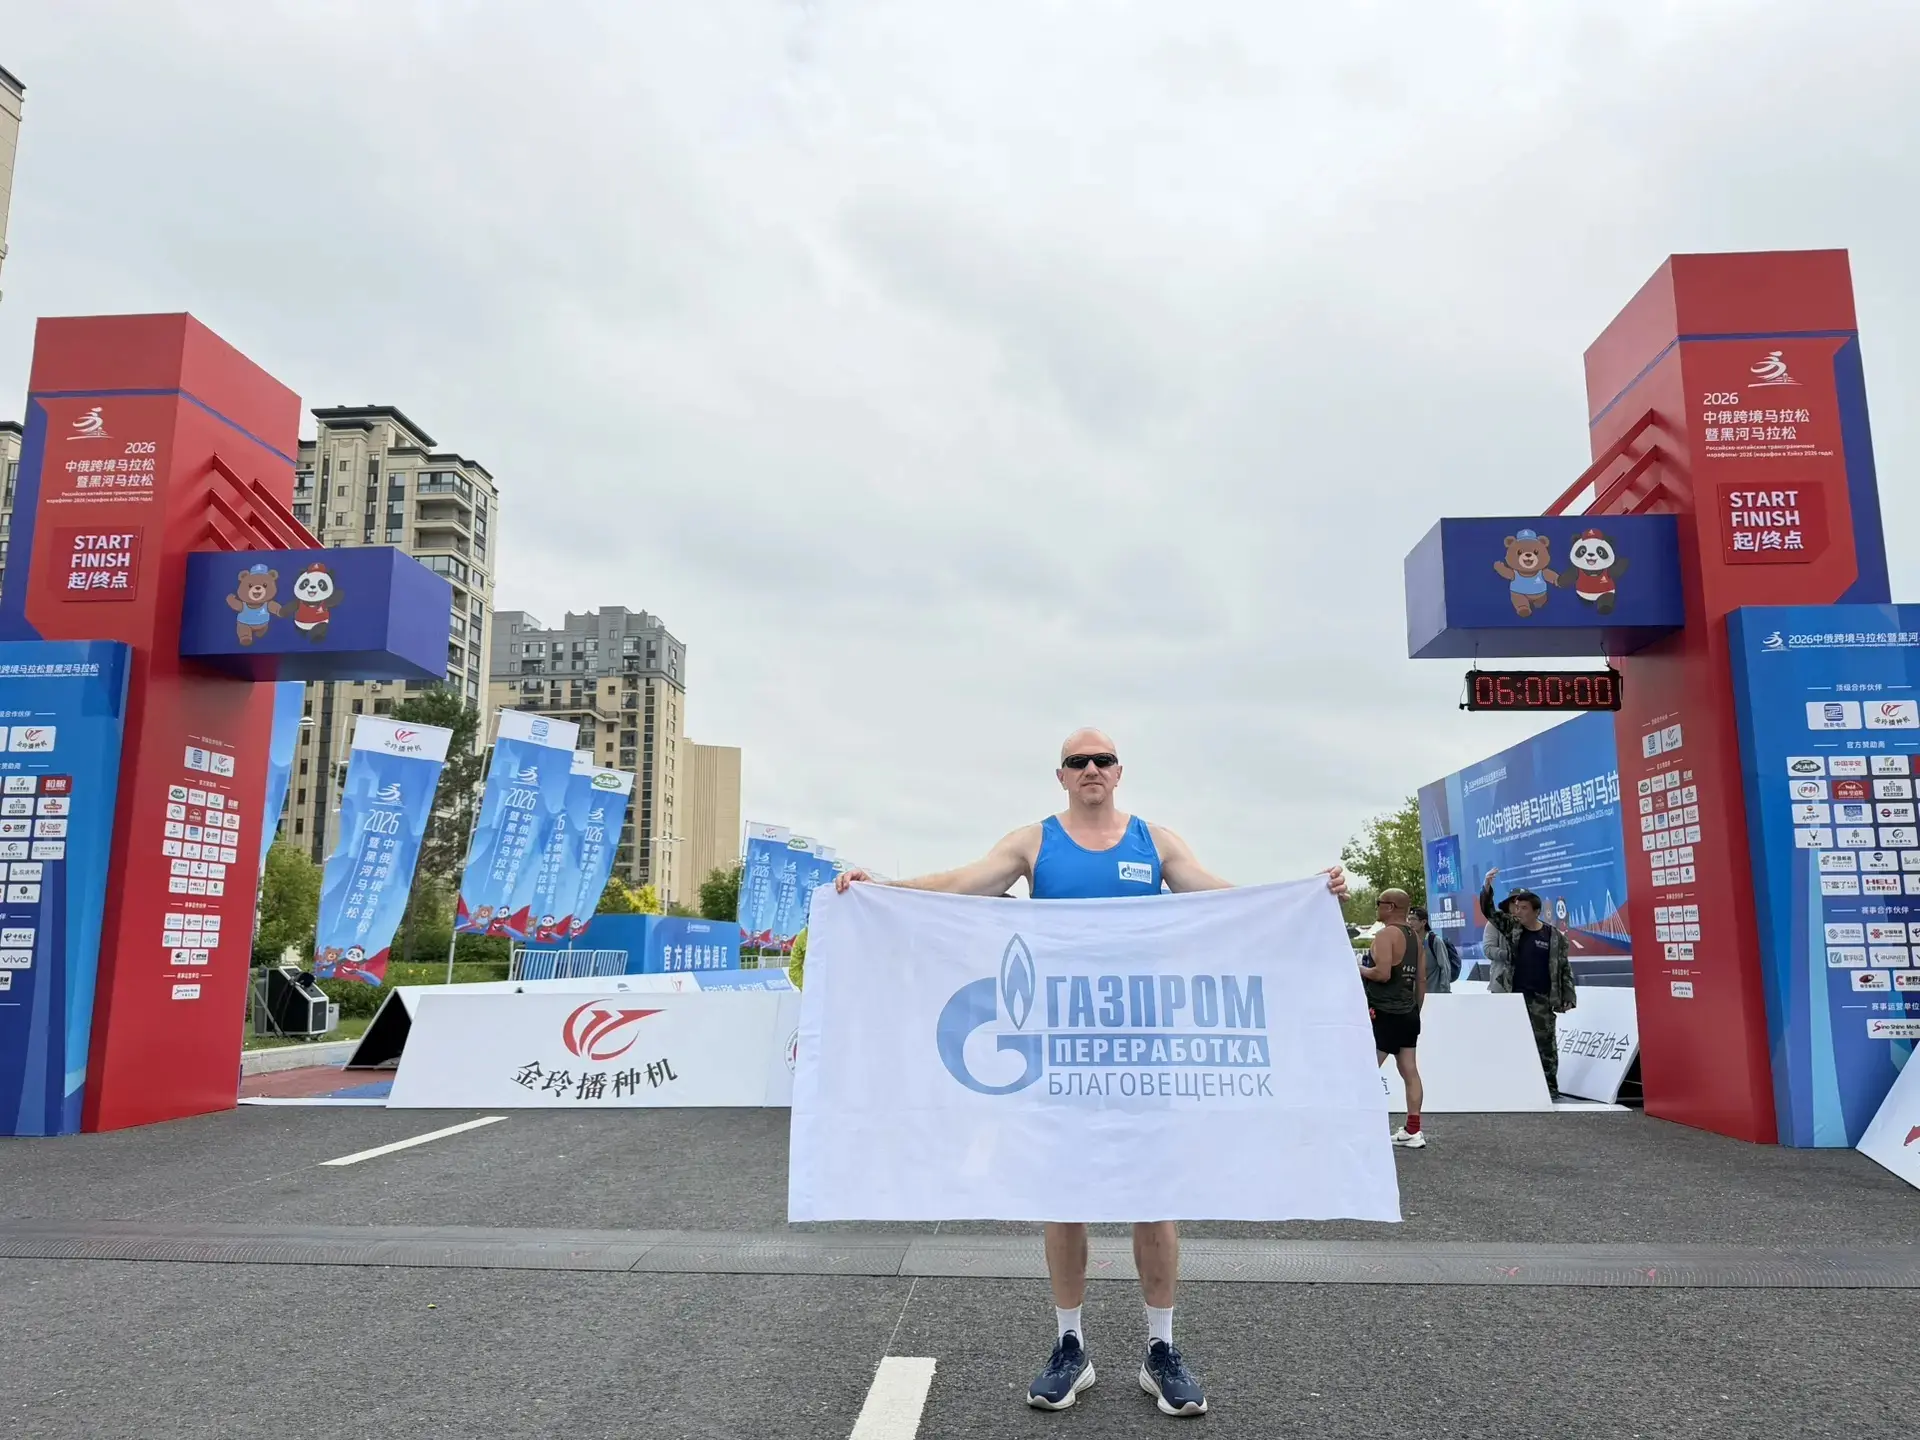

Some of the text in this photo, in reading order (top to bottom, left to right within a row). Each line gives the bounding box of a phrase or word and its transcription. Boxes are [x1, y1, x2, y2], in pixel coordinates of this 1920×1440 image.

[1703, 392, 1739, 405] 2026
[1703, 409, 1810, 424] 中俄跨境马拉松
[1705, 426, 1797, 442] 暨黑河马拉松
[125, 442, 156, 453] 2026
[65, 459, 154, 473] 中俄跨境马拉松
[75, 474, 153, 488] 暨黑河马拉松
[1730, 491, 1798, 507] START
[1731, 510, 1800, 527] FINISH
[74, 534, 133, 550] START
[1733, 530, 1804, 552] 起/终点
[71, 552, 130, 568] FINISH
[67, 571, 129, 590] 起/终点
[1788, 632, 1920, 645] 2026中俄跨境马拉松暨黑河
[0, 663, 99, 674] 跨境马拉松暨黑河马拉松
[1475, 676, 1612, 705] 06:00:00
[1836, 683, 1883, 692] 顶级合作伙伴
[1846, 741, 1886, 749] 官方赞助商
[505, 787, 540, 811] 2026
[363, 808, 402, 836] 2026
[585, 826, 605, 843] 026
[345, 836, 380, 920] 暨黑河马拉松
[1861, 906, 1909, 914] 赛事合作伙伴
[2, 955, 29, 963] vivo
[1046, 975, 1267, 1029] ГАЗПРОМ
[1055, 1038, 1265, 1064] ПЕРЕРАБОТКА
[511, 1057, 678, 1100] 金玲播种机
[1049, 1072, 1275, 1101] БЛАГОВЕЩЕНСК
